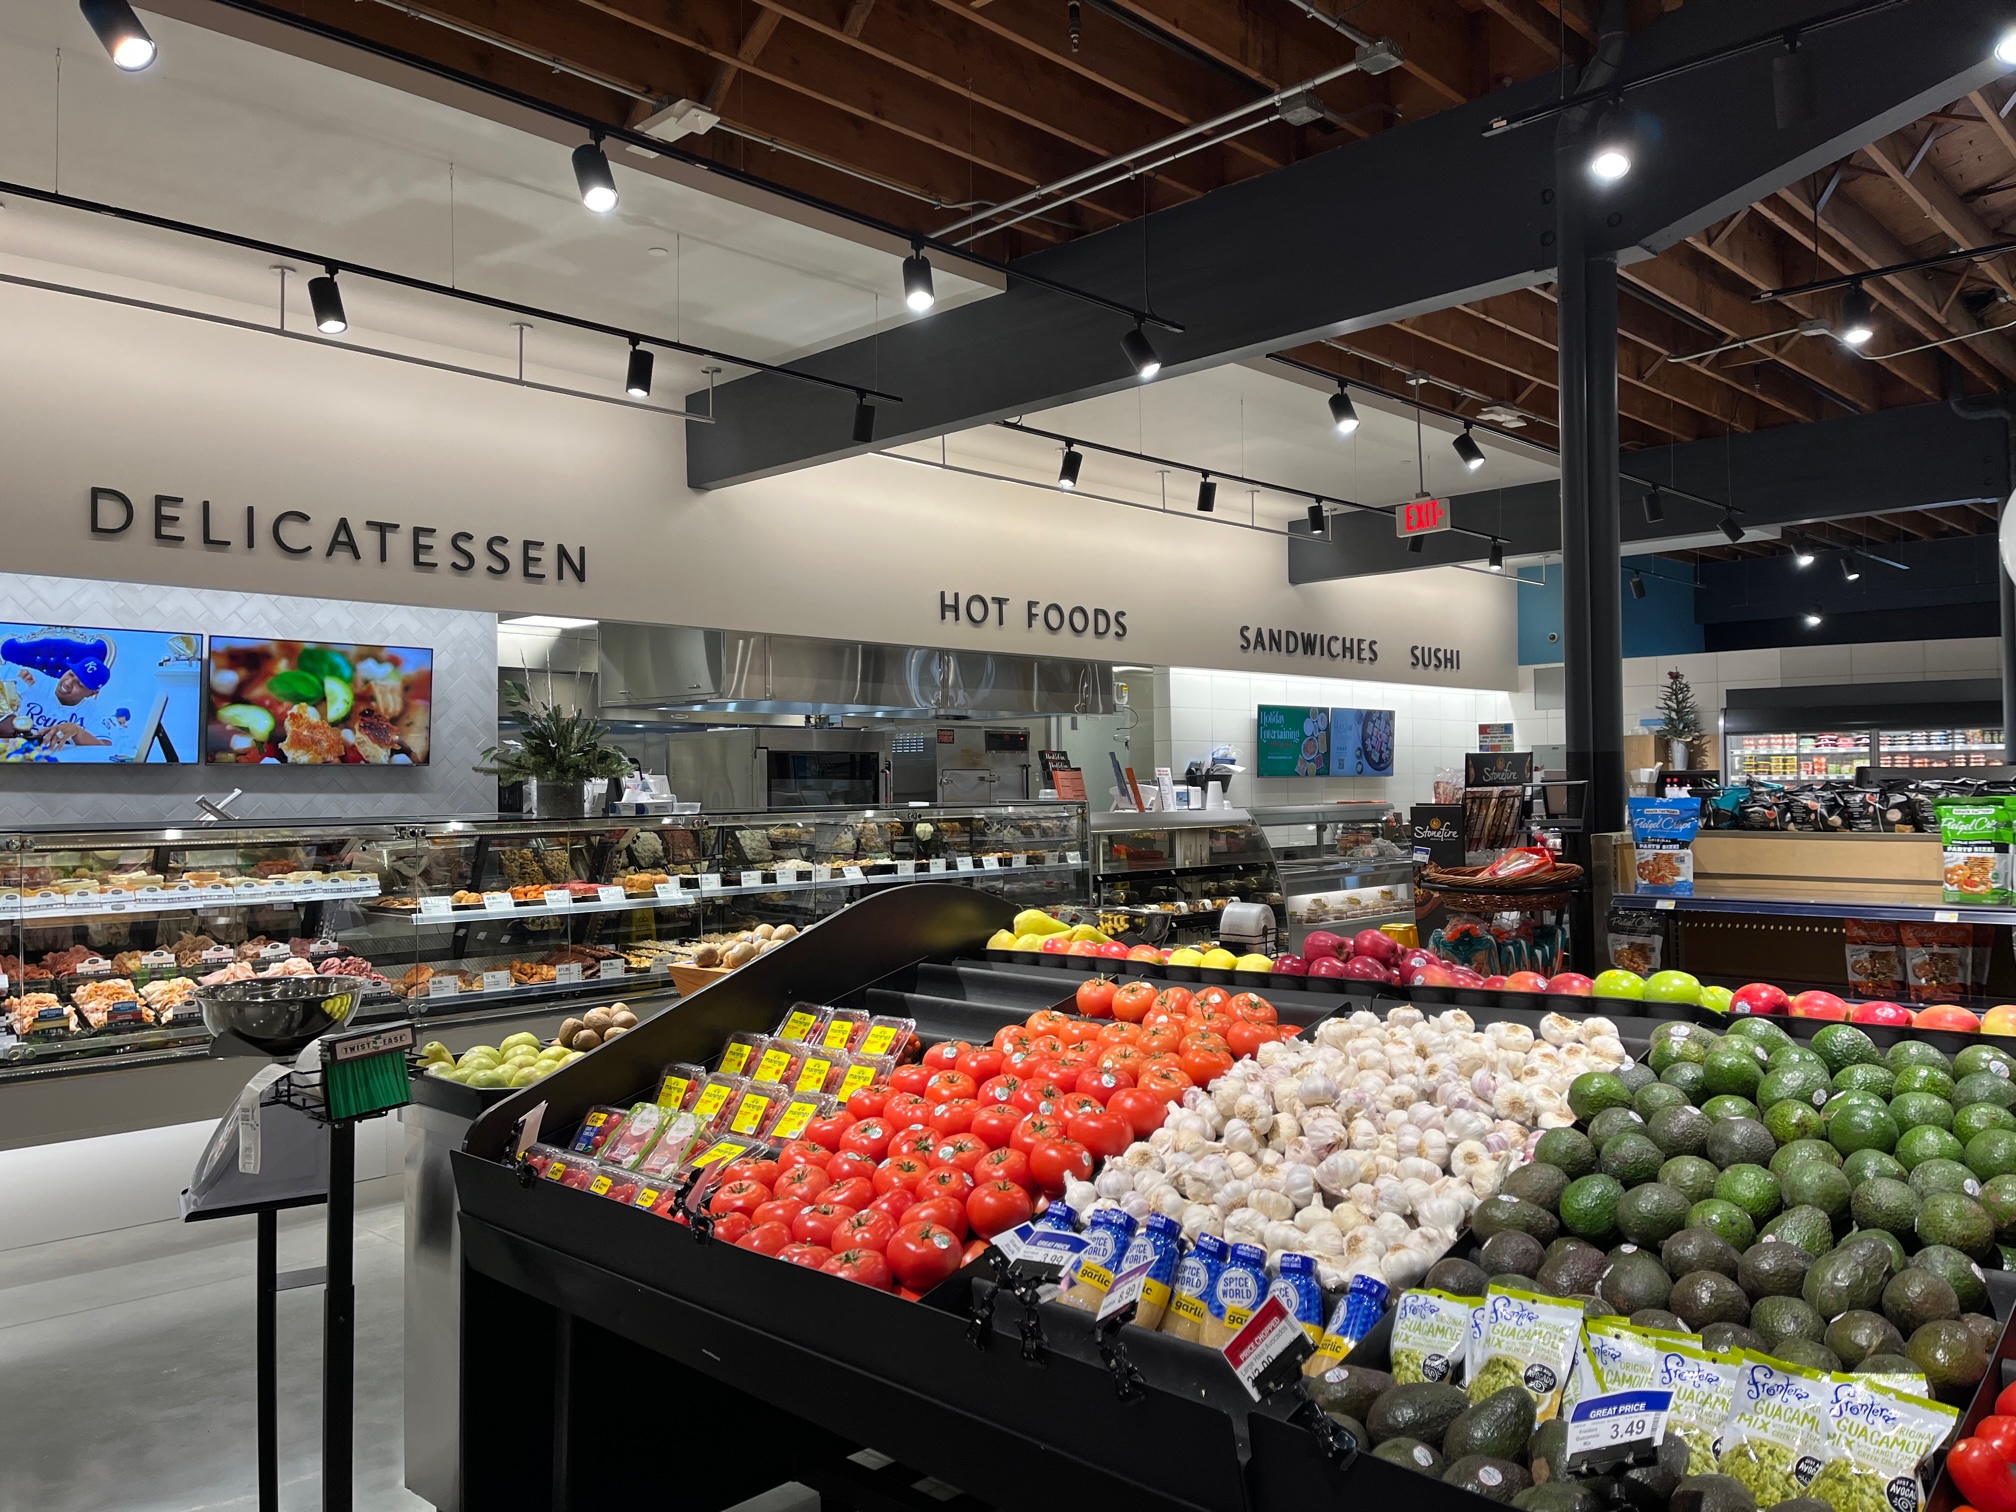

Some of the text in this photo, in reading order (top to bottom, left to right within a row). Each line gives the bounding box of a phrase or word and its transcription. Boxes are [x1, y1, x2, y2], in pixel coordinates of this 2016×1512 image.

[1405, 500, 1439, 532] EXIT
[90, 486, 586, 583] DELICATESSEN
[940, 590, 1128, 638] HOT FOODS
[1239, 625, 1379, 663] SANDWICHES
[84, 660, 98, 674] KC
[1410, 645, 1461, 670] SUSHI
[26, 702, 86, 730] Royals
[1482, 761, 1518, 782] Stonefire
[1414, 822, 1459, 842] Stonefire
[1633, 817, 1661, 833] Pretzel
[1941, 818, 1975, 836] Pretzel
[343, 1042, 371, 1054] TWIST
[1081, 1266, 1111, 1288] garlic
[1179, 1264, 1201, 1277] SPICE
[1176, 1275, 1201, 1288] WORLD
[1223, 1277, 1249, 1288] SPICE
[1222, 1287, 1252, 1300] WORLD
[1239, 1342, 1257, 1362] PRICE
[1254, 1317, 1281, 1346] CHOPPED
[1394, 1332, 1411, 1344] MIX
[1400, 1317, 1464, 1342] GUACAMOLE
[1491, 1323, 1567, 1349] GUACAMOLE
[1240, 1325, 1289, 1377] Large Hass Avocados
[1485, 1337, 1504, 1349] MIX
[1527, 1370, 1555, 1387] AVOCADO
[1590, 1403, 1646, 1419] GREAT PRICE
[1753, 1400, 1820, 1435] GUACAM
[1610, 1419, 1646, 1440] 3.49
[1737, 1411, 1769, 1434] MIX
[1827, 1431, 1855, 1449] MIX
[1835, 1417, 1933, 1458] GUACAMOLE
[1798, 1463, 1818, 1476] AVOC
[1889, 1484, 1917, 1500] AVOCA
